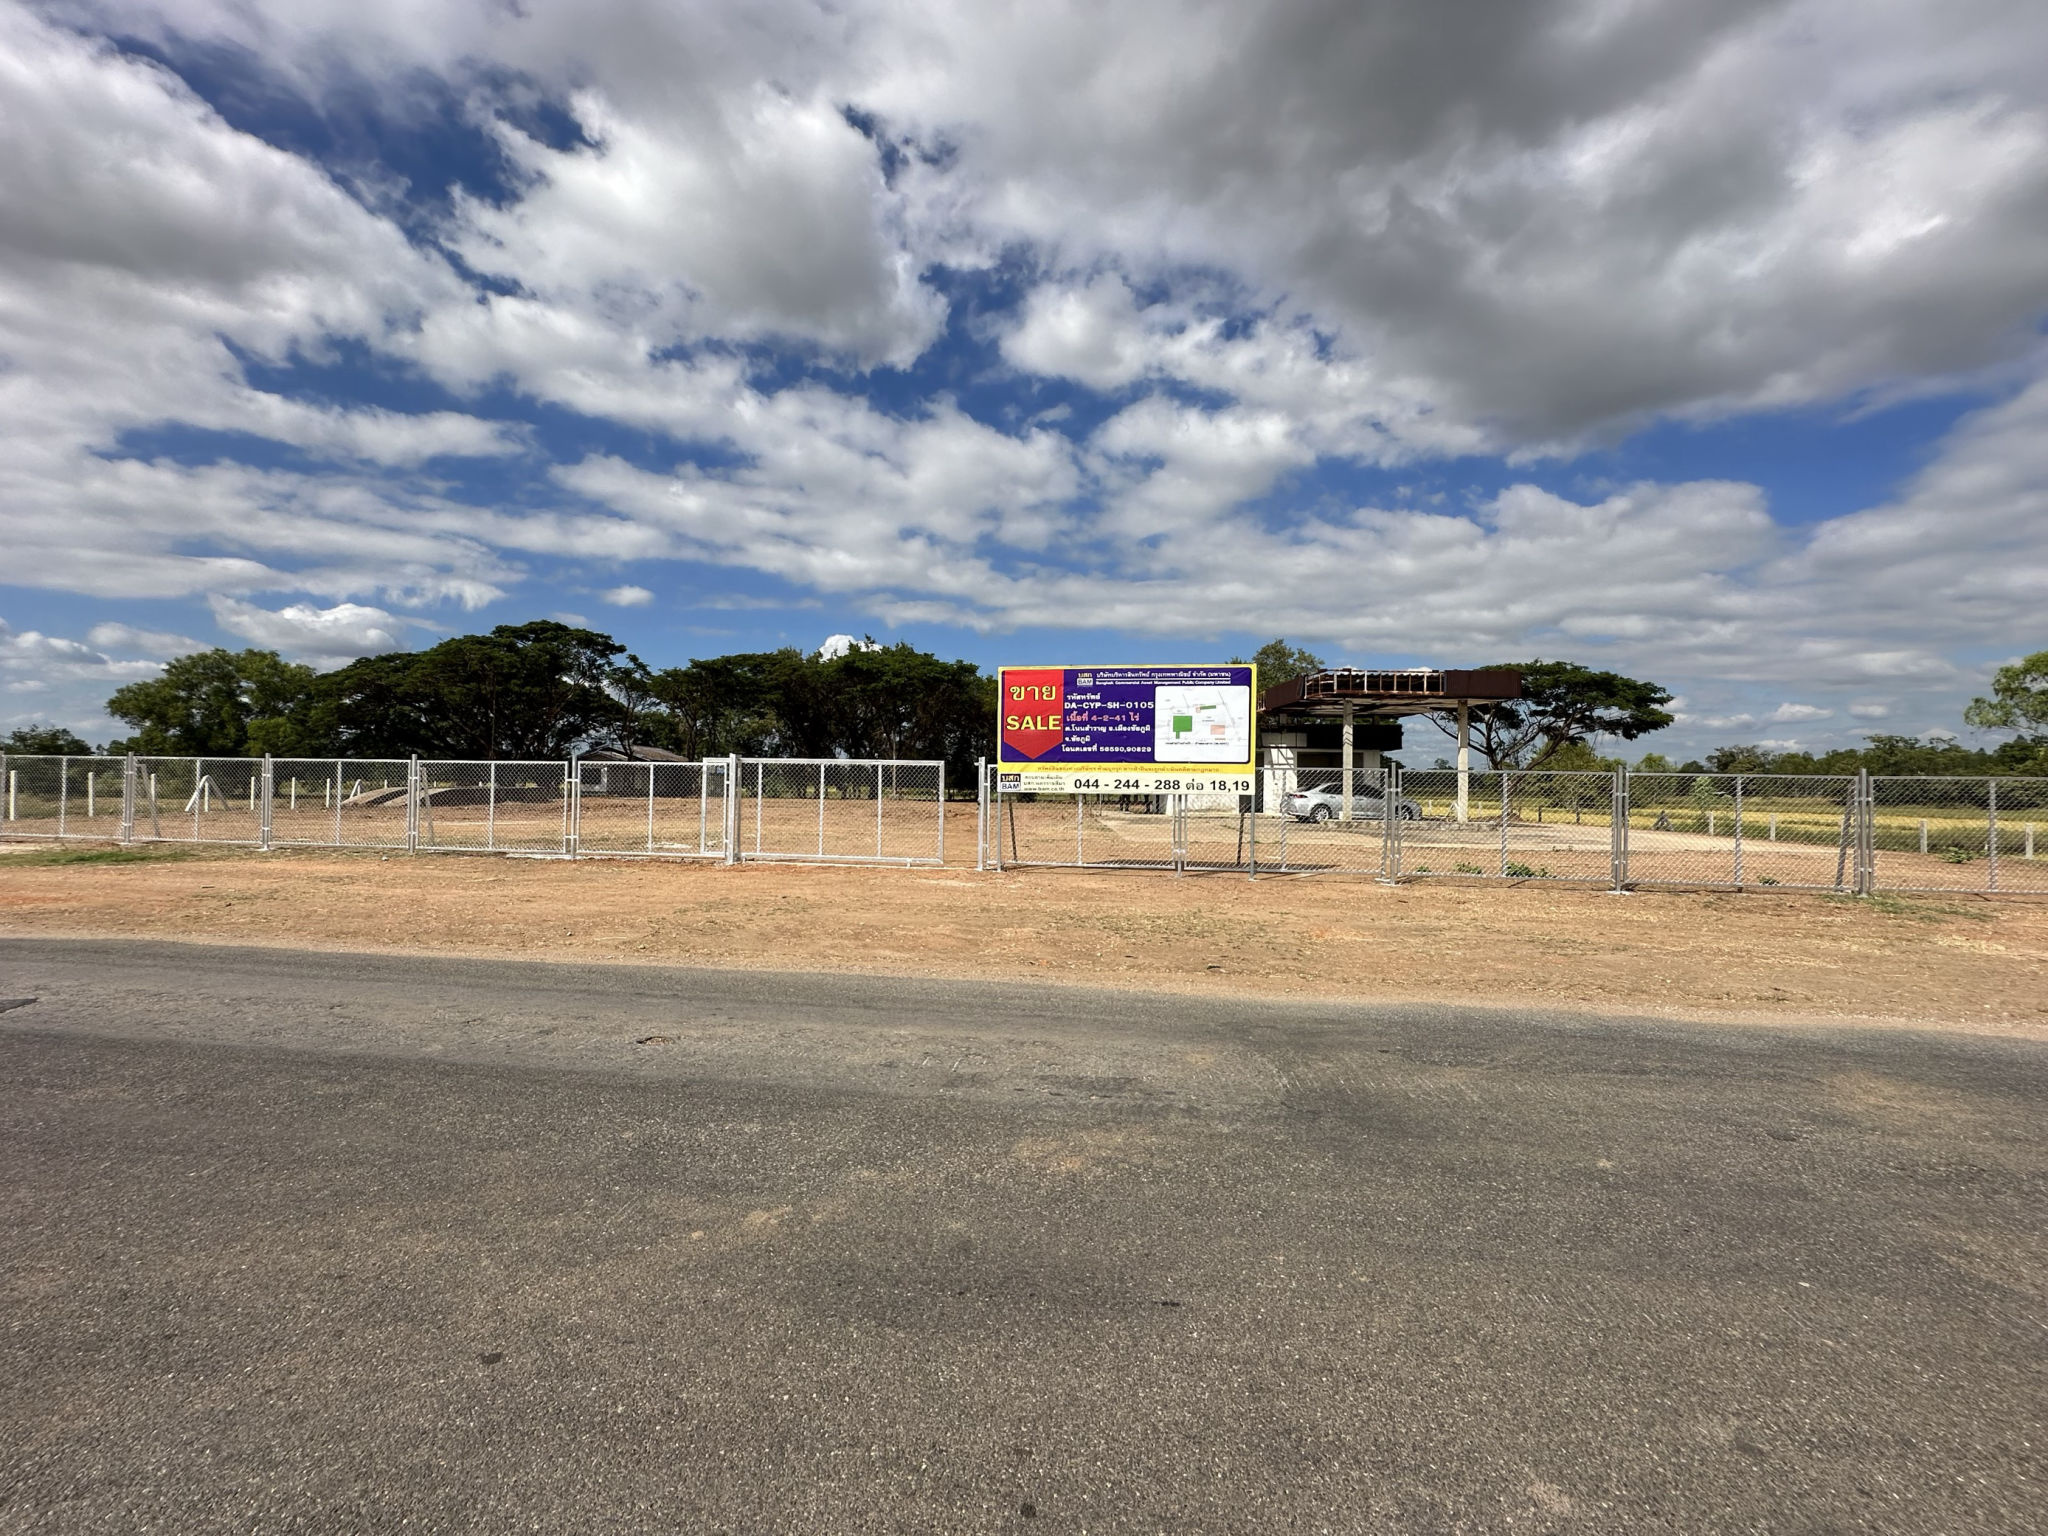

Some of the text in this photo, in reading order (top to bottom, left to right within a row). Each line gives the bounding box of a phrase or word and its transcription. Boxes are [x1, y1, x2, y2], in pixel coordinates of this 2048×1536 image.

[1009, 685, 1056, 701] ขาย
[1064, 701, 1154, 709] DA-CYP-SH-0105
[1006, 716, 1062, 731] SALE
[1066, 710, 1140, 722] เนื้อที่ 4-2-41 ไร่
[1074, 779, 1100, 790] 044
[1113, 779, 1140, 790] 244
[1154, 780, 1181, 790] 288
[1185, 778, 1204, 791] ต่อ
[1209, 780, 1250, 793] 18,19
